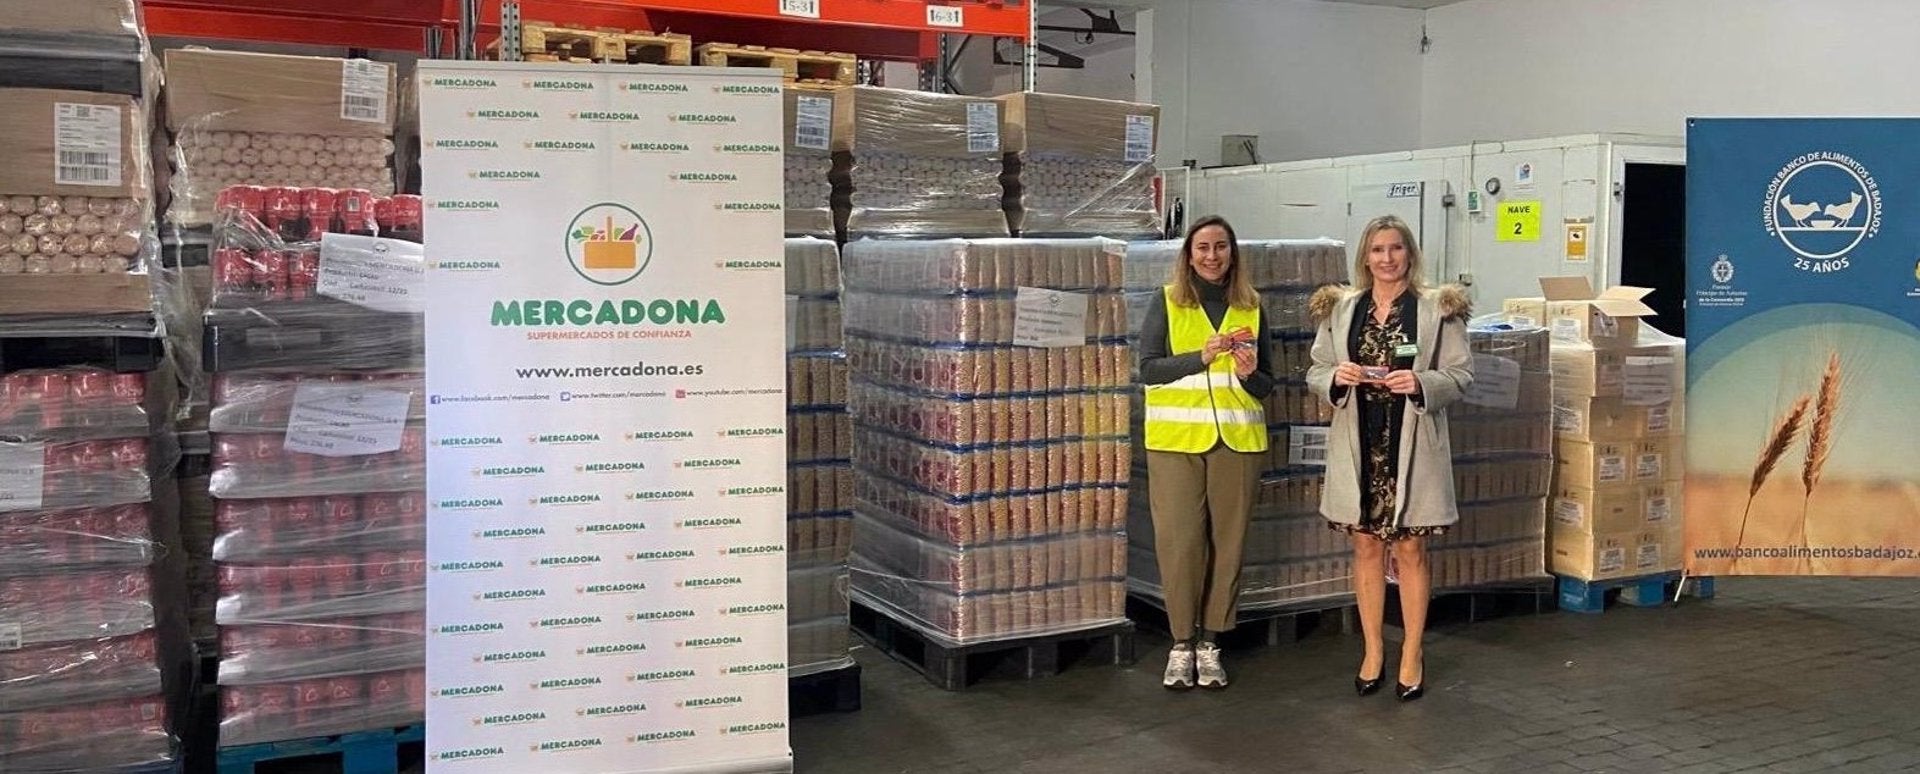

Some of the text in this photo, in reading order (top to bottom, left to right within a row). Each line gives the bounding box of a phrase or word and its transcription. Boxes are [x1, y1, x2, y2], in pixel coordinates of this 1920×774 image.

[434, 79, 496, 87] MERCADONA
[534, 81, 593, 90] MERCADONA
[629, 83, 688, 92] MERCADONA
[722, 86, 779, 94] MERCADONA
[478, 110, 539, 118] MERCADONA
[580, 112, 639, 120] MERCADONA
[678, 114, 736, 122] MERCADONA
[436, 140, 498, 148] MERCADONA
[534, 142, 595, 150] MERCADONA
[630, 143, 689, 151] MERCADONA
[724, 144, 780, 152] MERCADONA
[479, 170, 540, 178] MERCADONA
[679, 173, 737, 181] MERCADONA
[1764, 151, 1882, 234] FUNDACIÓN BANCO DE ALIMENTOS DE BADAJOZ
[1508, 205, 1530, 214] NAVE
[1514, 223, 1522, 234] 2
[439, 261, 500, 269] MERCADONA
[1794, 257, 1850, 273] 25 AÑOS
[491, 299, 726, 326] MERCADONA
[527, 329, 692, 340] SUPERMERCADOS DE CONFIANZA
[516, 362, 703, 378] www.mercadona.es
[635, 431, 693, 440] MERCADONA
[728, 428, 783, 436] MERCADONA
[441, 437, 502, 446] MERCADONA
[539, 434, 600, 442] MERCADONA
[586, 462, 644, 471] MERCADONA
[684, 458, 740, 467] MERCADONA
[483, 466, 544, 476] MERCADONA
[636, 491, 694, 500] MERCADONA
[728, 486, 784, 495] MERCADONA
[441, 498, 503, 508] MERCADONA
[540, 494, 600, 504] MERCADONA
[586, 522, 645, 532] MERCADONA
[684, 518, 741, 527] MERCADONA
[484, 528, 545, 537] MERCADONA
[729, 544, 784, 554] MERCADONA
[1695, 544, 1920, 561] www.bancoalimentosbadajoz.
[540, 556, 600, 565] MERCADONA
[636, 551, 694, 560] MERCADONA
[441, 560, 503, 570] MERCADONA
[684, 577, 742, 587] MERCADONA
[586, 584, 646, 593] MERCADONA
[484, 589, 546, 599] MERCADONA
[729, 604, 784, 614] MERCADONA
[636, 610, 695, 620] MERCADONA
[540, 616, 601, 626] MERCADONA
[441, 622, 503, 632] MERCADONA
[685, 636, 742, 647] MERCADONA
[586, 644, 646, 654] MERCADONA
[484, 650, 546, 661] MERCADONA
[729, 663, 785, 674] MERCADONA
[637, 670, 695, 680] MERCADONA
[540, 677, 601, 688] MERCADONA
[441, 684, 504, 696] MERCADONA
[685, 696, 742, 706] MERCADONA
[587, 704, 646, 714] MERCADONA
[484, 712, 546, 724] MERCADONA
[730, 723, 785, 733] MERCADONA
[637, 730, 696, 740] MERCADONA
[541, 738, 602, 750] MERCADONA
[441, 747, 504, 759] MERCADONA
